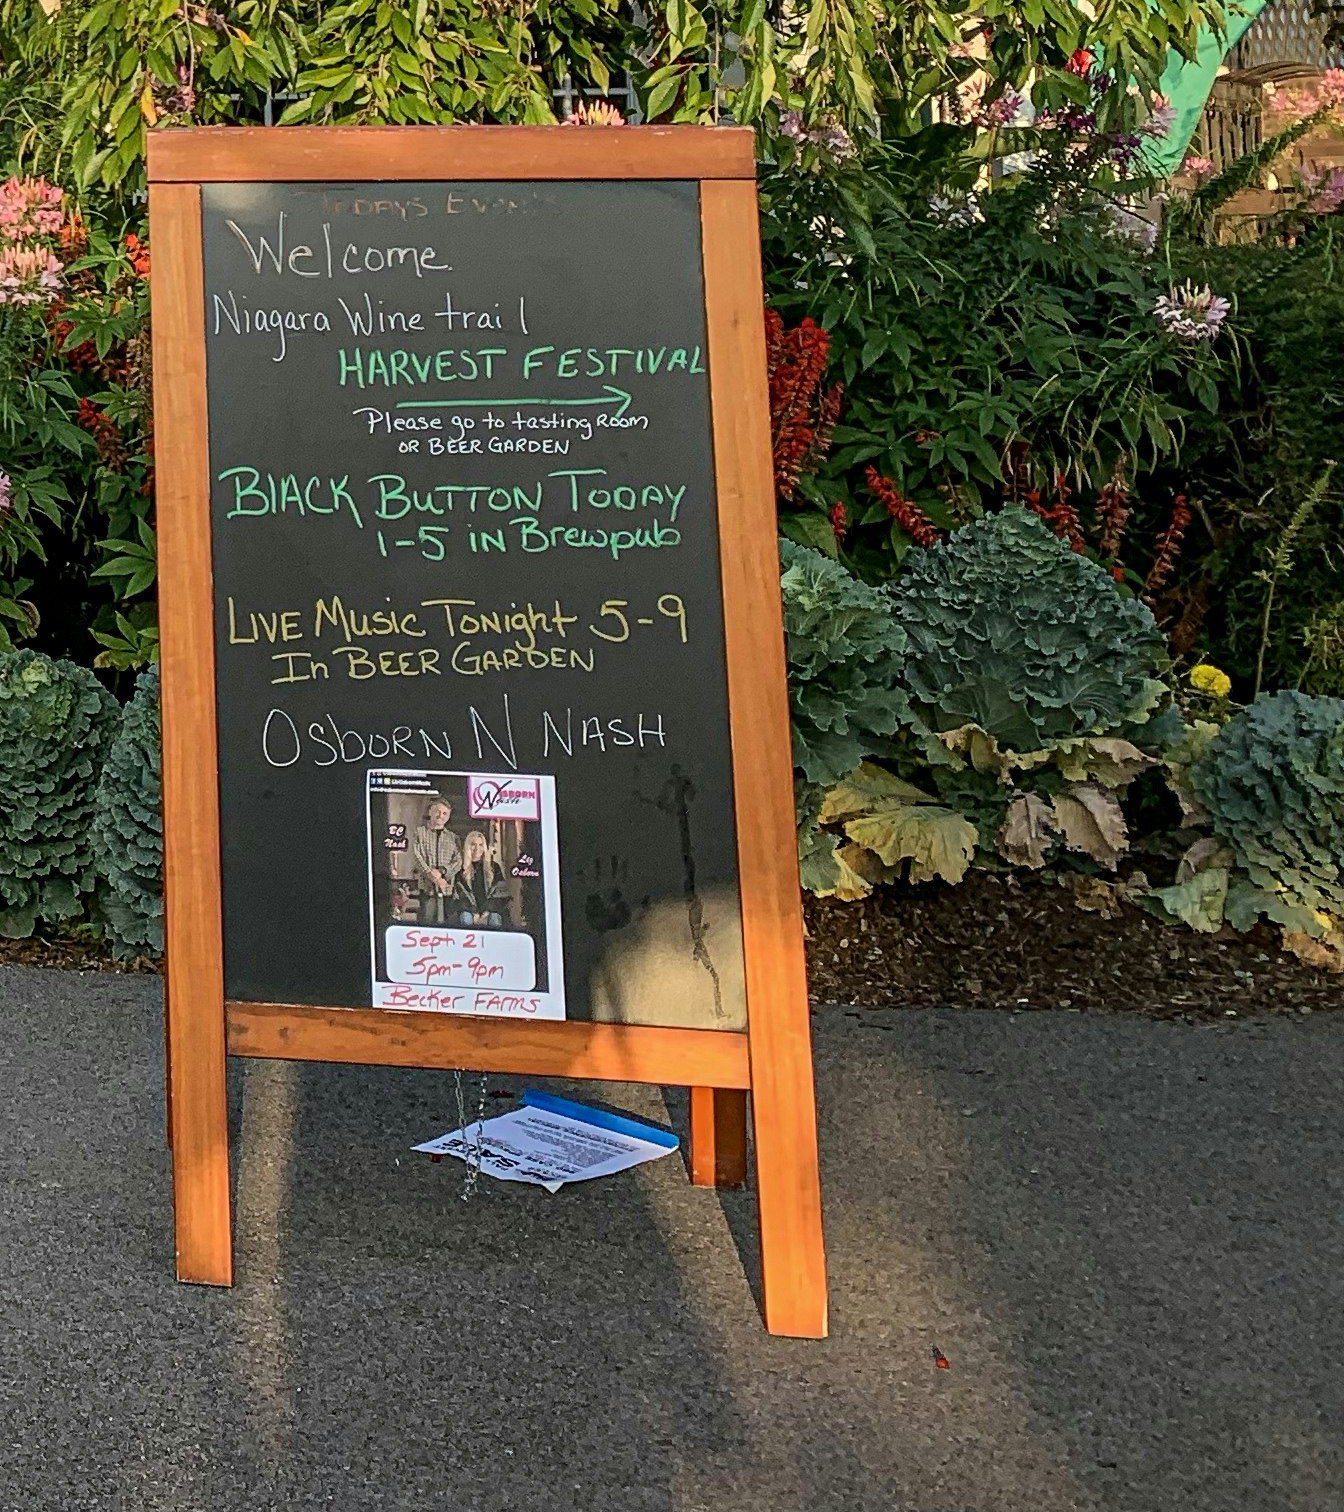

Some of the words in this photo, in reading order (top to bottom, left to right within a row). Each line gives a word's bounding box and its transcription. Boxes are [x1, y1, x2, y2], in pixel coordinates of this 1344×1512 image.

[225, 211, 453, 278] Welcome
[213, 294, 331, 361] Niagara
[338, 296, 425, 336] Wine
[339, 347, 507, 388] HARVEST
[523, 344, 706, 380] FESTIVAL
[352, 407, 443, 434] Please
[451, 415, 475, 443] go
[482, 411, 505, 430] to
[512, 411, 593, 440] tasting
[399, 440, 419, 454] OR
[428, 438, 483, 455] BEER
[488, 438, 570, 455] GARDEN
[548, 468, 687, 521] TODAY
[376, 524, 450, 561] 1-5
[508, 516, 681, 560] Brewpub
[227, 596, 303, 645] LIVE
[270, 650, 330, 684] In
[332, 646, 442, 678] BEER
[450, 641, 595, 675] GARDEN
[470, 693, 518, 771] N
[542, 707, 666, 758] NASH
[462, 933, 485, 949] 21
